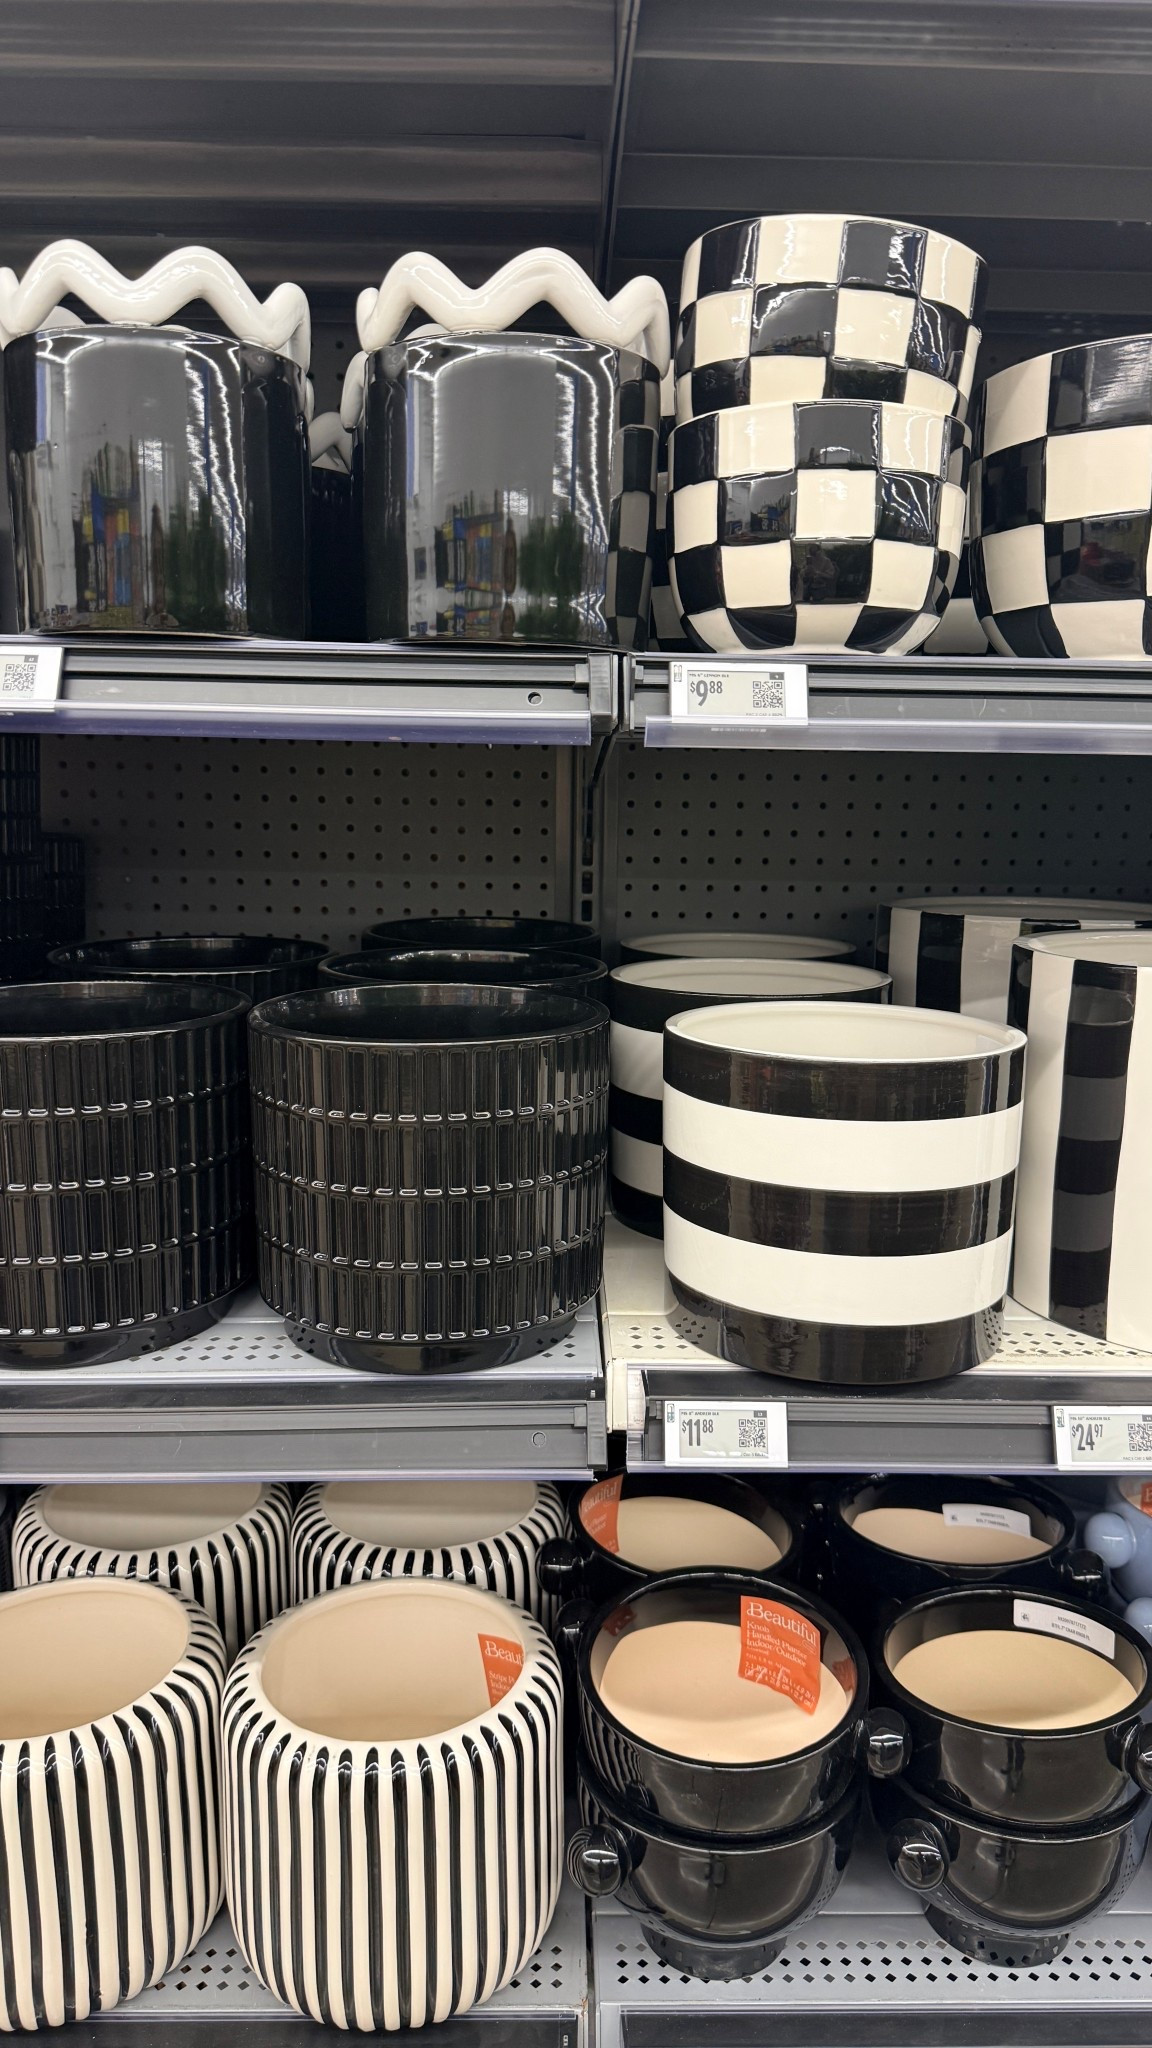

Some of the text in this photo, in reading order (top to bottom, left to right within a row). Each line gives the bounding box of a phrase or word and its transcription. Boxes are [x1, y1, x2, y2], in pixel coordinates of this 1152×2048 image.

[746, 1602, 817, 1647] Beautiful
[747, 1620, 770, 1633] Knob
[747, 1629, 781, 1646] Handled
[781, 1640, 808, 1660] Planter
